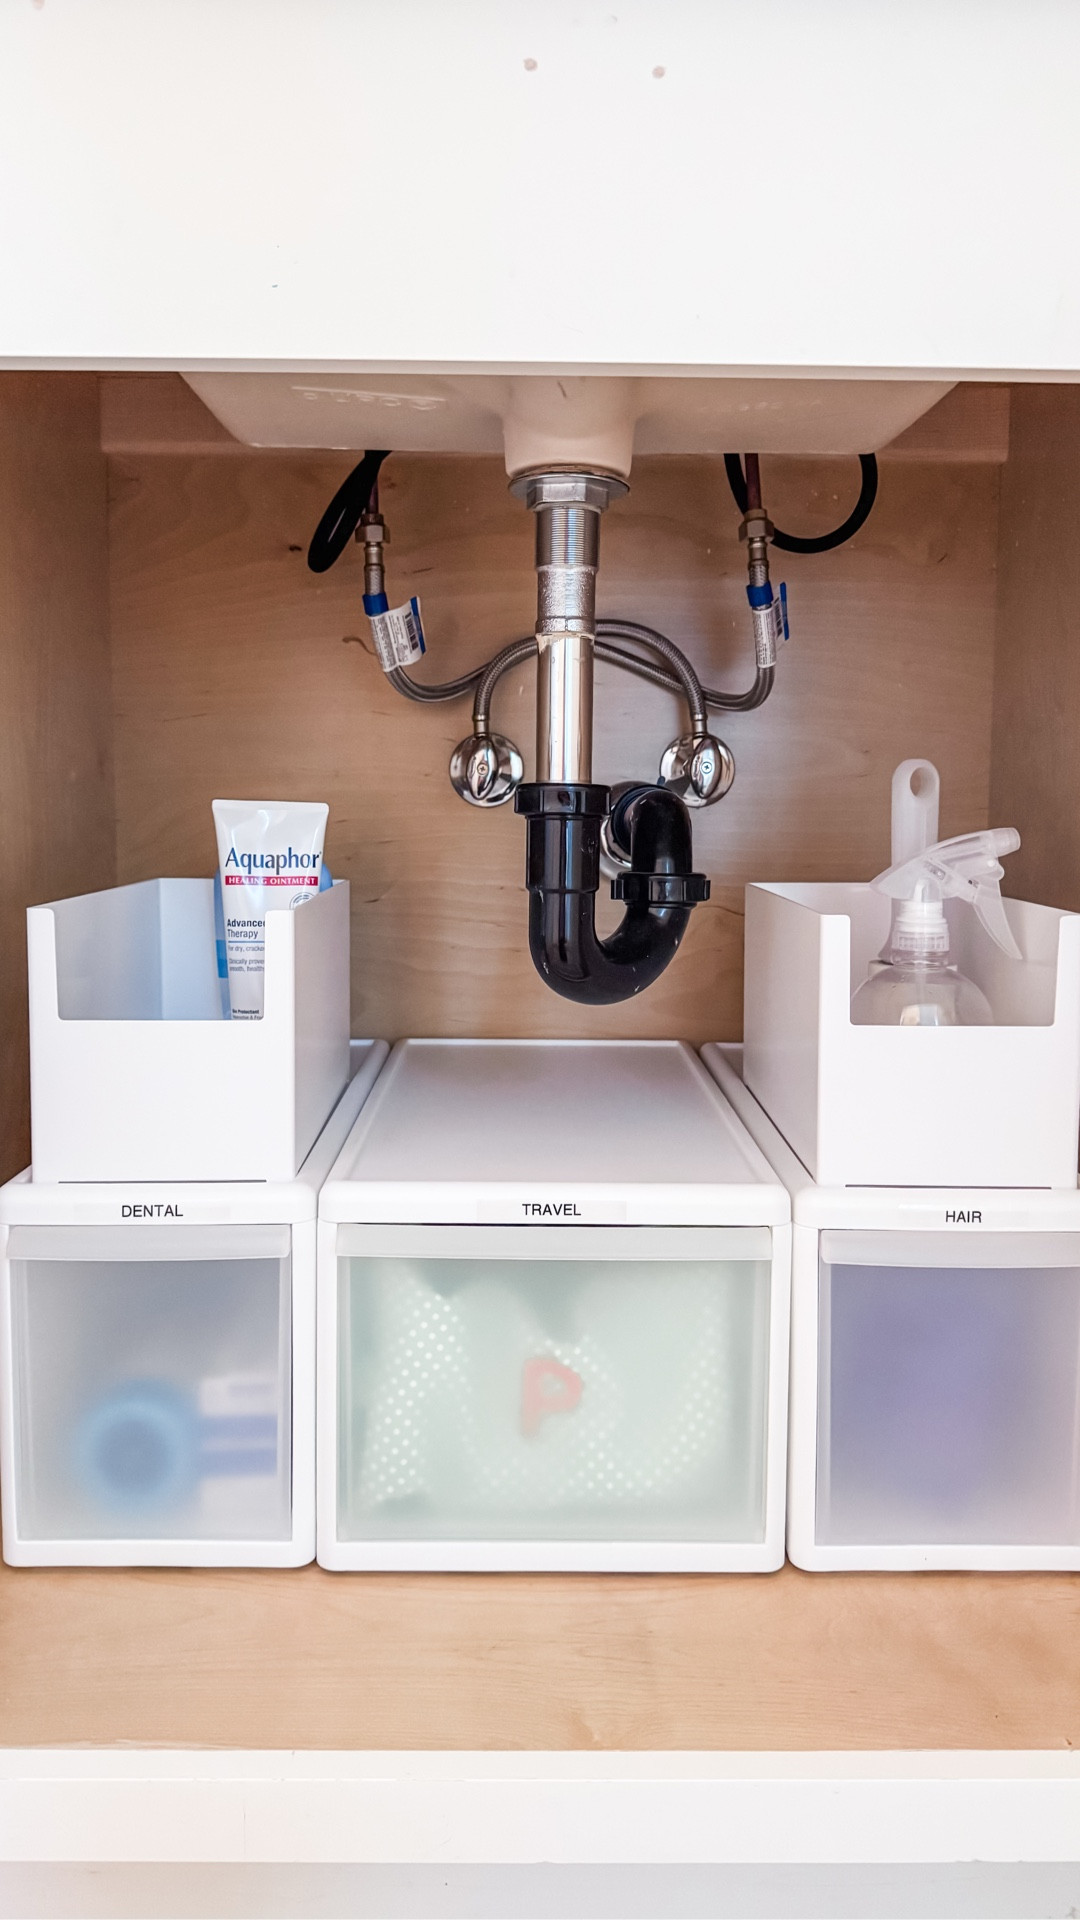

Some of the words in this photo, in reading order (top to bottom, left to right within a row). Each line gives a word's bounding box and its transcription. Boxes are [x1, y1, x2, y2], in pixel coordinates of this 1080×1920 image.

[225, 847, 320, 875] Aquaphor
[228, 876, 268, 885] HEALING
[270, 877, 316, 885] OINTMENT
[227, 929, 259, 939] Therapy
[121, 1204, 184, 1218] DENTAL
[521, 1203, 582, 1216] TRAVEL
[945, 1210, 982, 1223] HAIR
